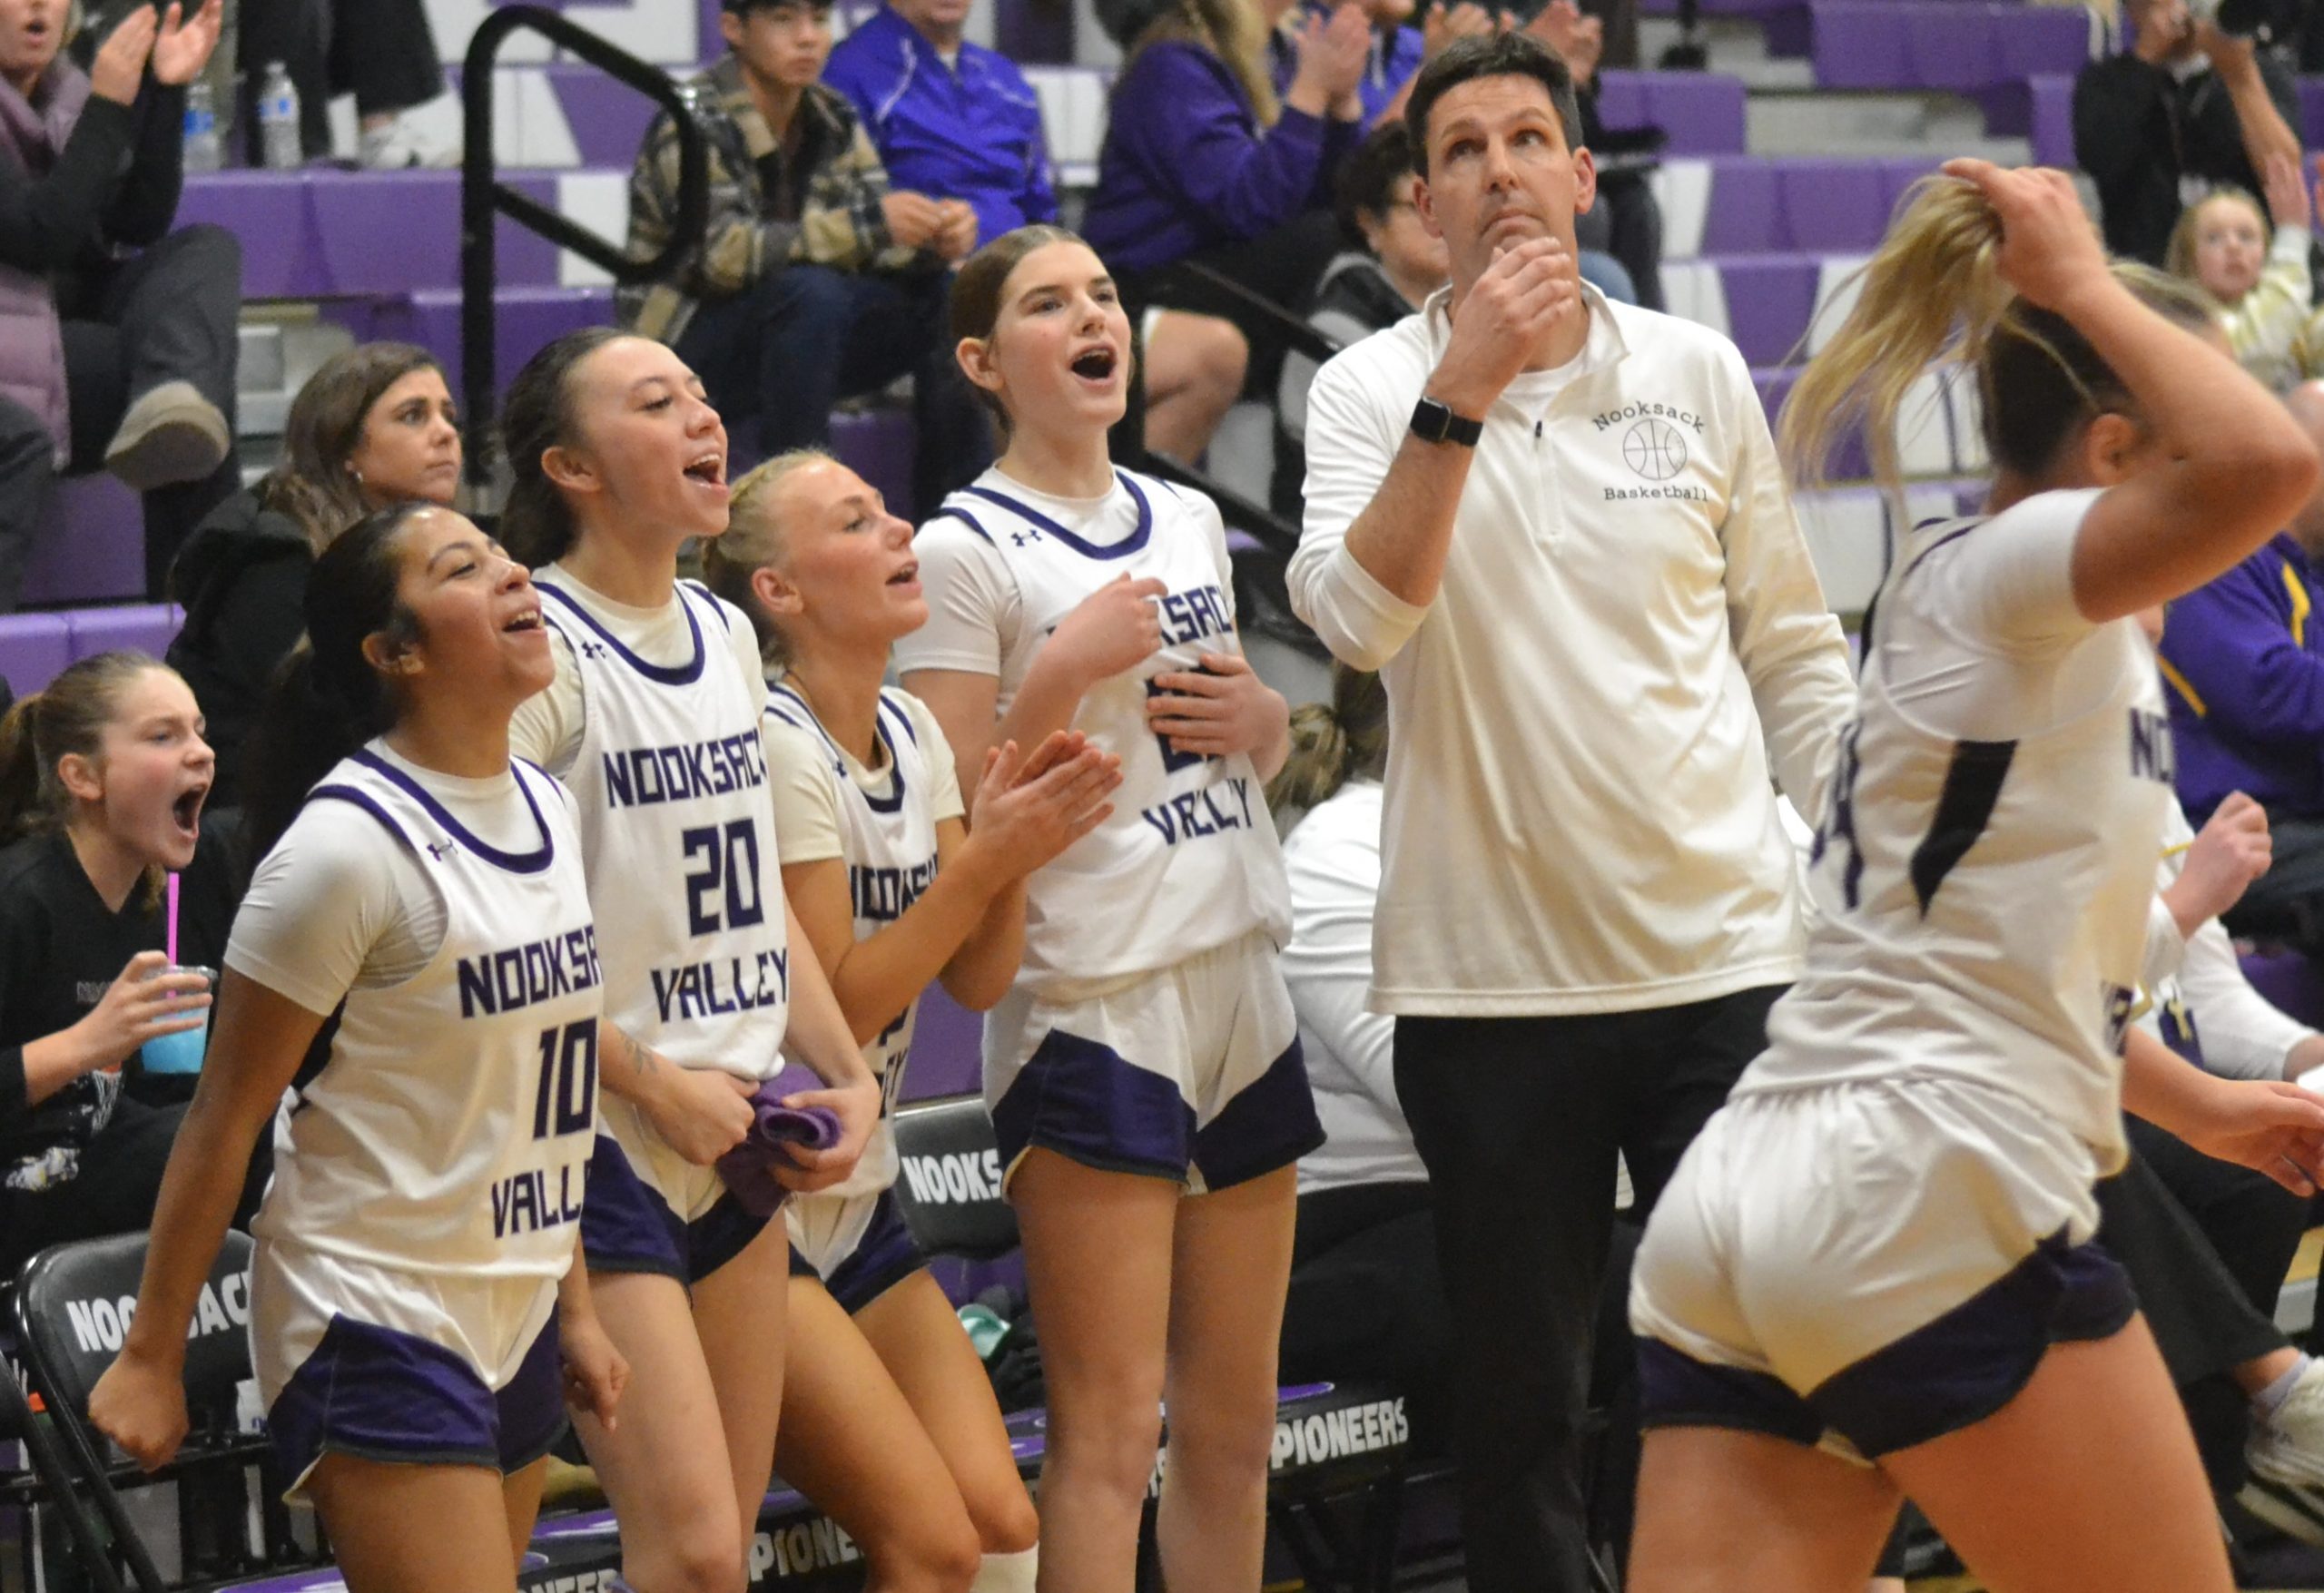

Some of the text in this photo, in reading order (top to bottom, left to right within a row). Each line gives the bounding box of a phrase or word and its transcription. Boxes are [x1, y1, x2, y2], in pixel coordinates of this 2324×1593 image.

[1592, 400, 1705, 434] Nooksack
[1604, 485, 1709, 501] Basketball
[682, 817, 763, 938] 20
[650, 949, 786, 1022] VALLEY
[534, 1017, 596, 1140] 10
[1272, 1398, 1409, 1469] PIONEERS
